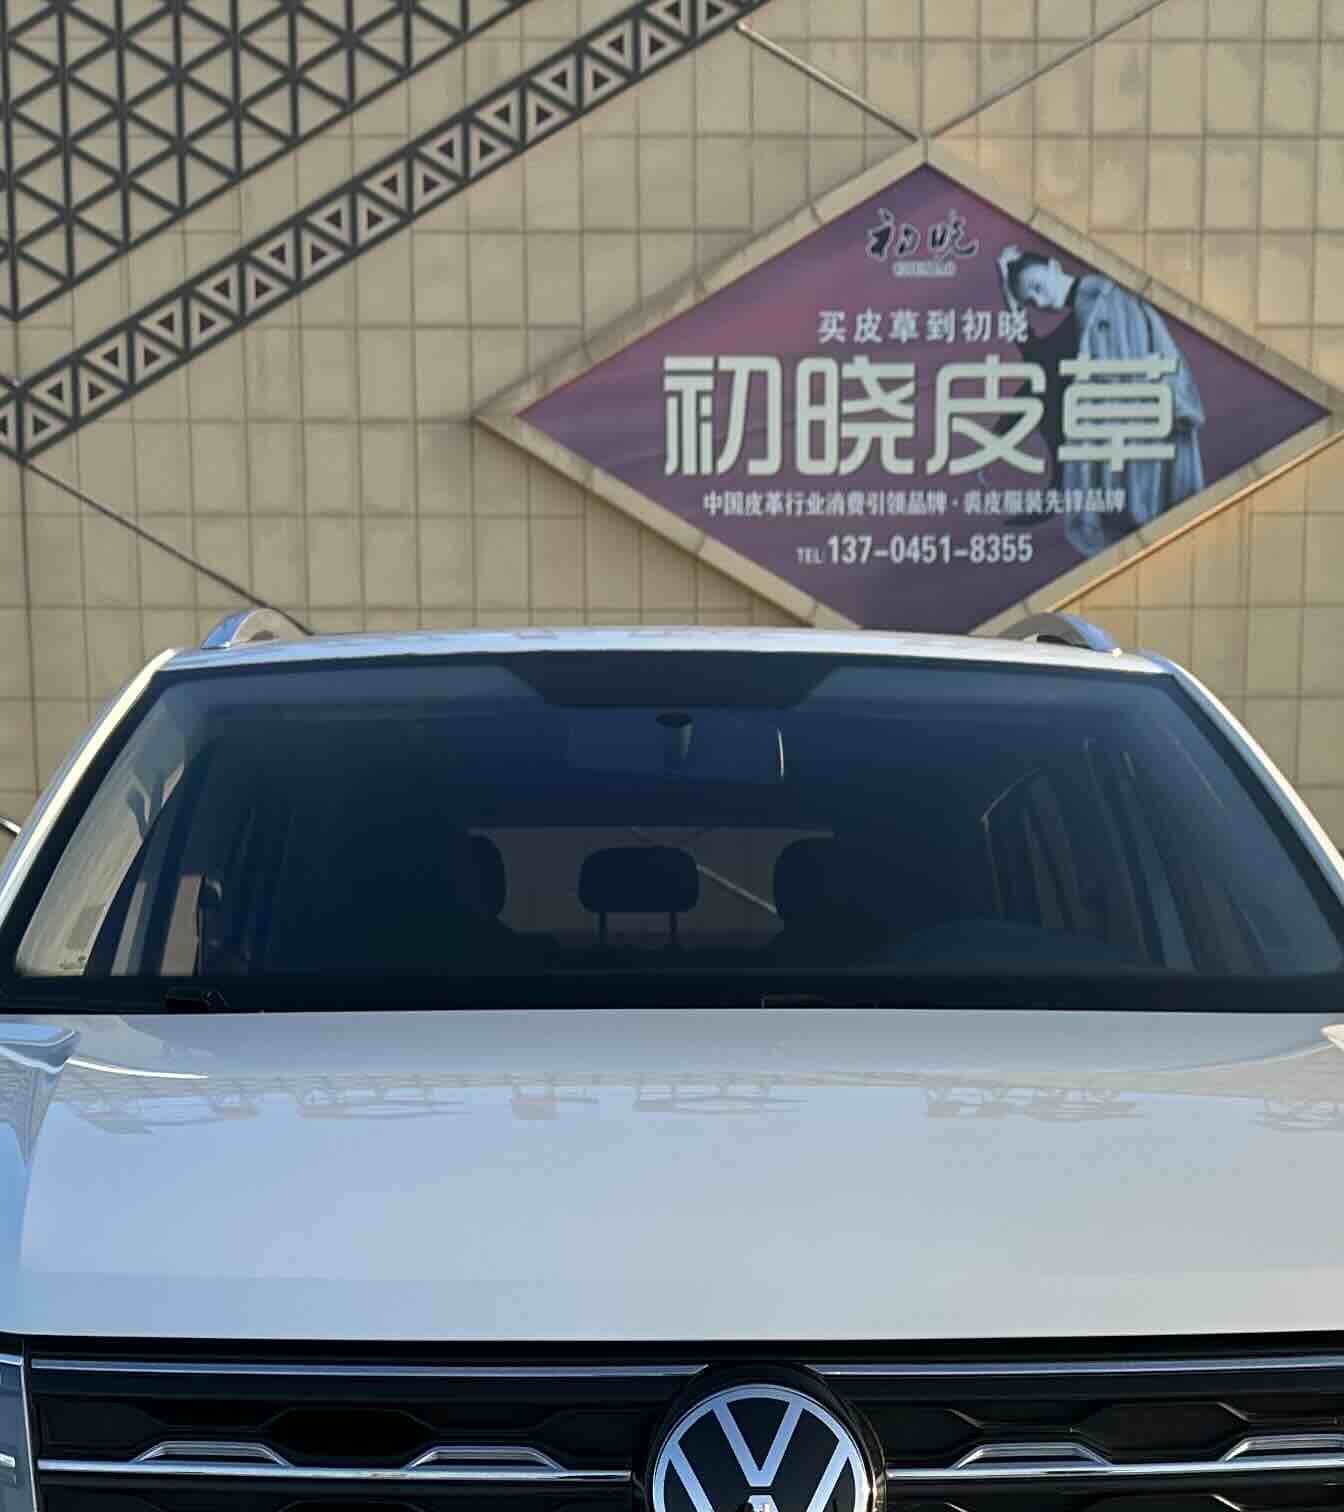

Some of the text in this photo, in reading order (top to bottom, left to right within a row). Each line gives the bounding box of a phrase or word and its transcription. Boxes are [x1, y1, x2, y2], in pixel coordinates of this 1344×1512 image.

[817, 307, 1029, 344] 买皮草到初晓
[663, 354, 1178, 475] 初晓皮草
[827, 534, 1033, 564] 137-0451-8355
